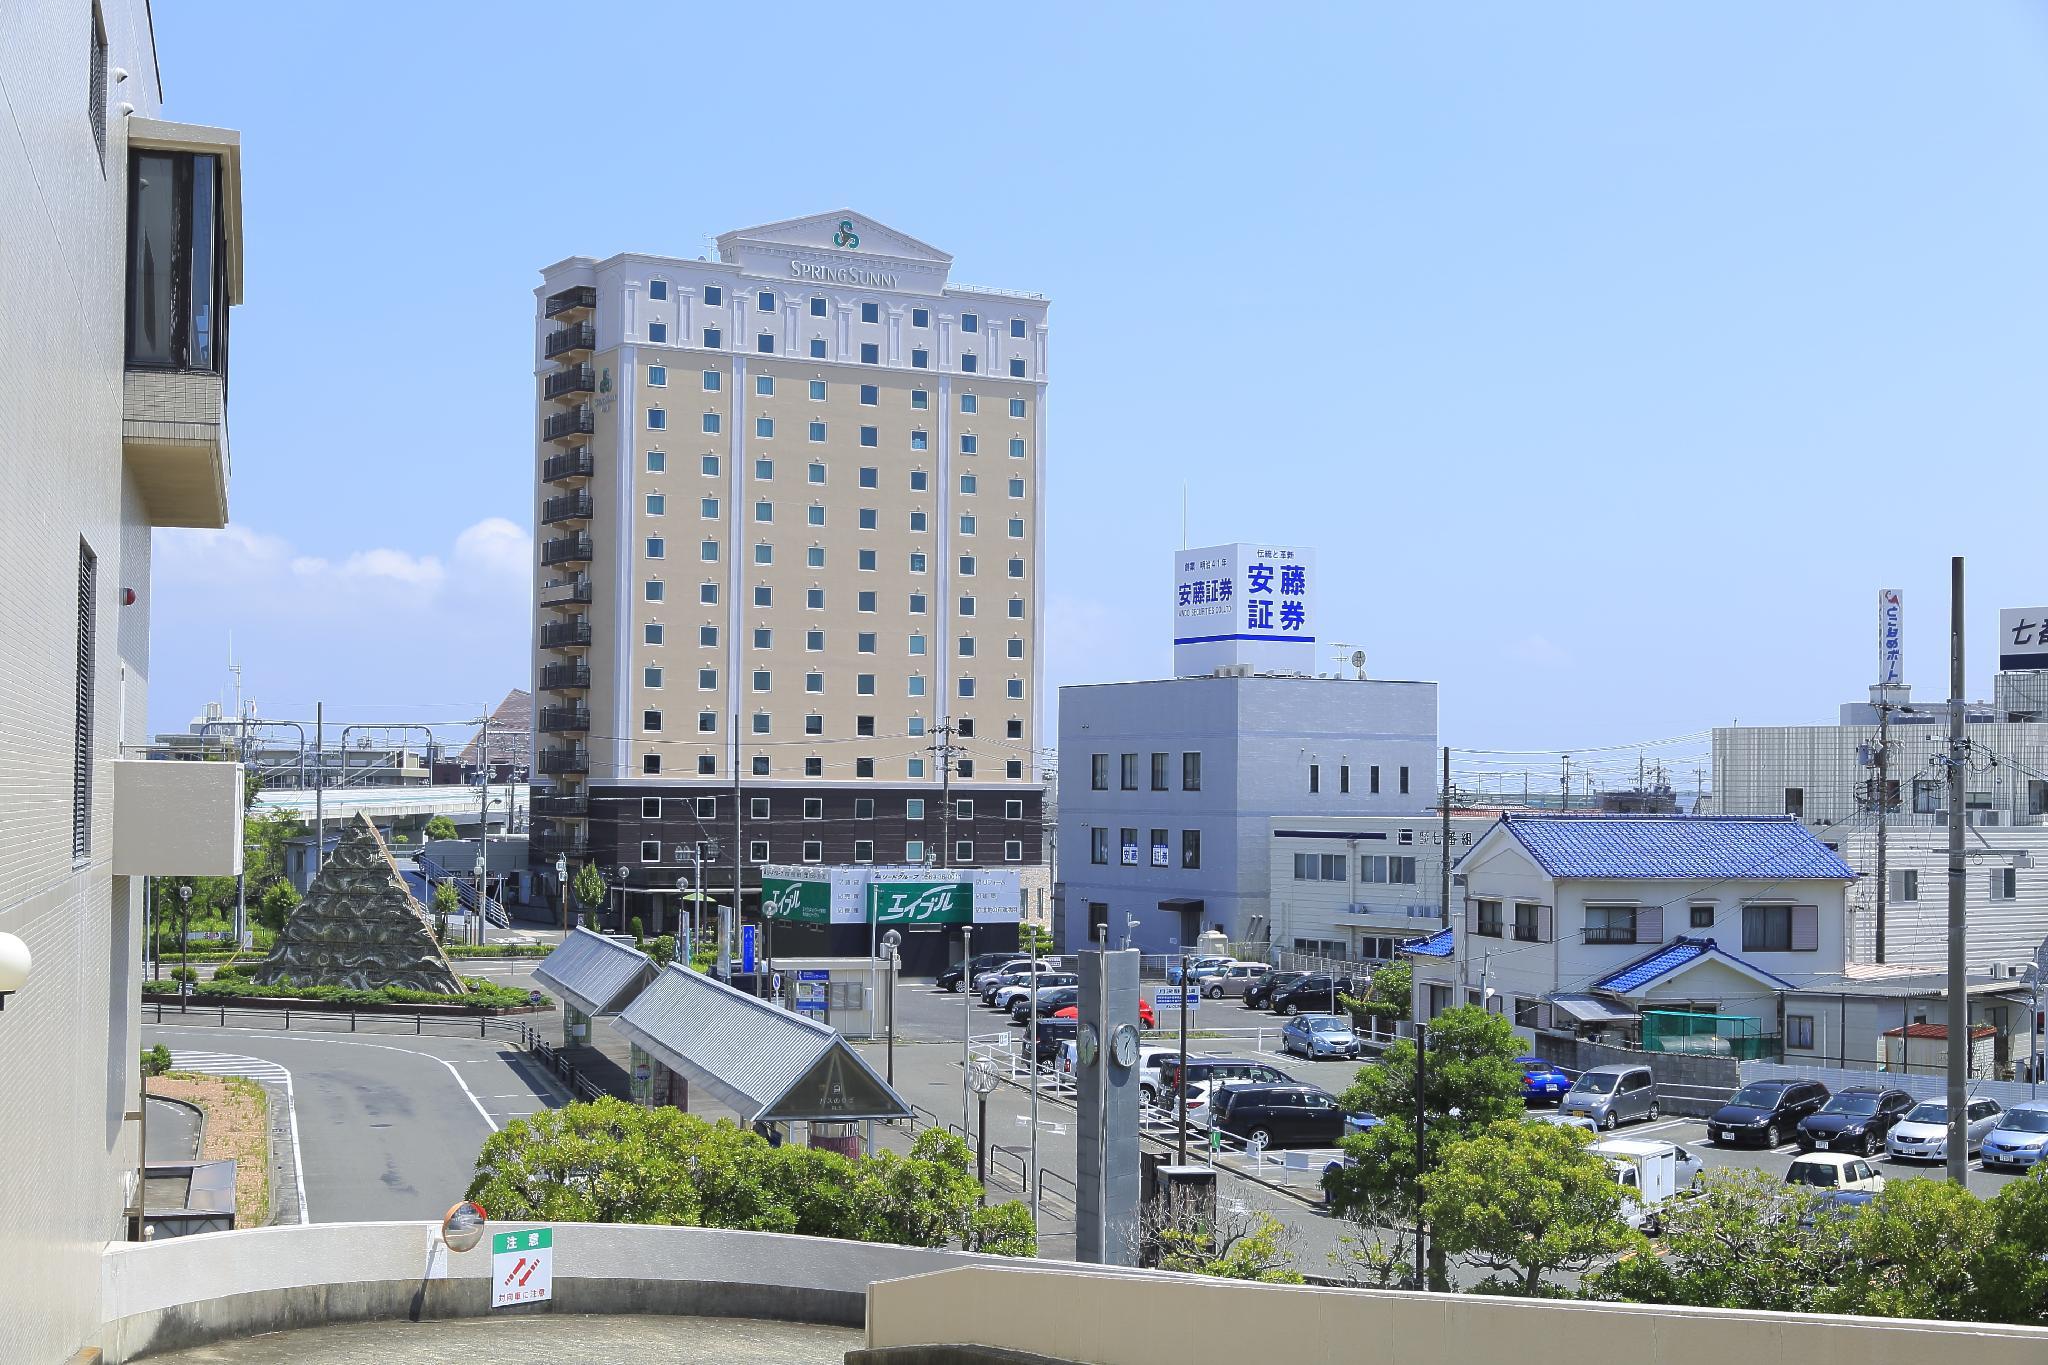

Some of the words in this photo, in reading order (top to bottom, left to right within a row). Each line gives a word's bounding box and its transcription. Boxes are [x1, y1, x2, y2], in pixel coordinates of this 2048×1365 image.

[790, 260, 846, 283] SPRING
[849, 267, 901, 289] SUNNY
[1178, 577, 1233, 606] 安藤証券
[1247, 562, 1306, 596] 安藤
[1247, 599, 1306, 631] 証券
[882, 886, 957, 920] エイブル
[506, 1232, 539, 1250] 注意
[498, 1288, 545, 1303] 対向車に注意
